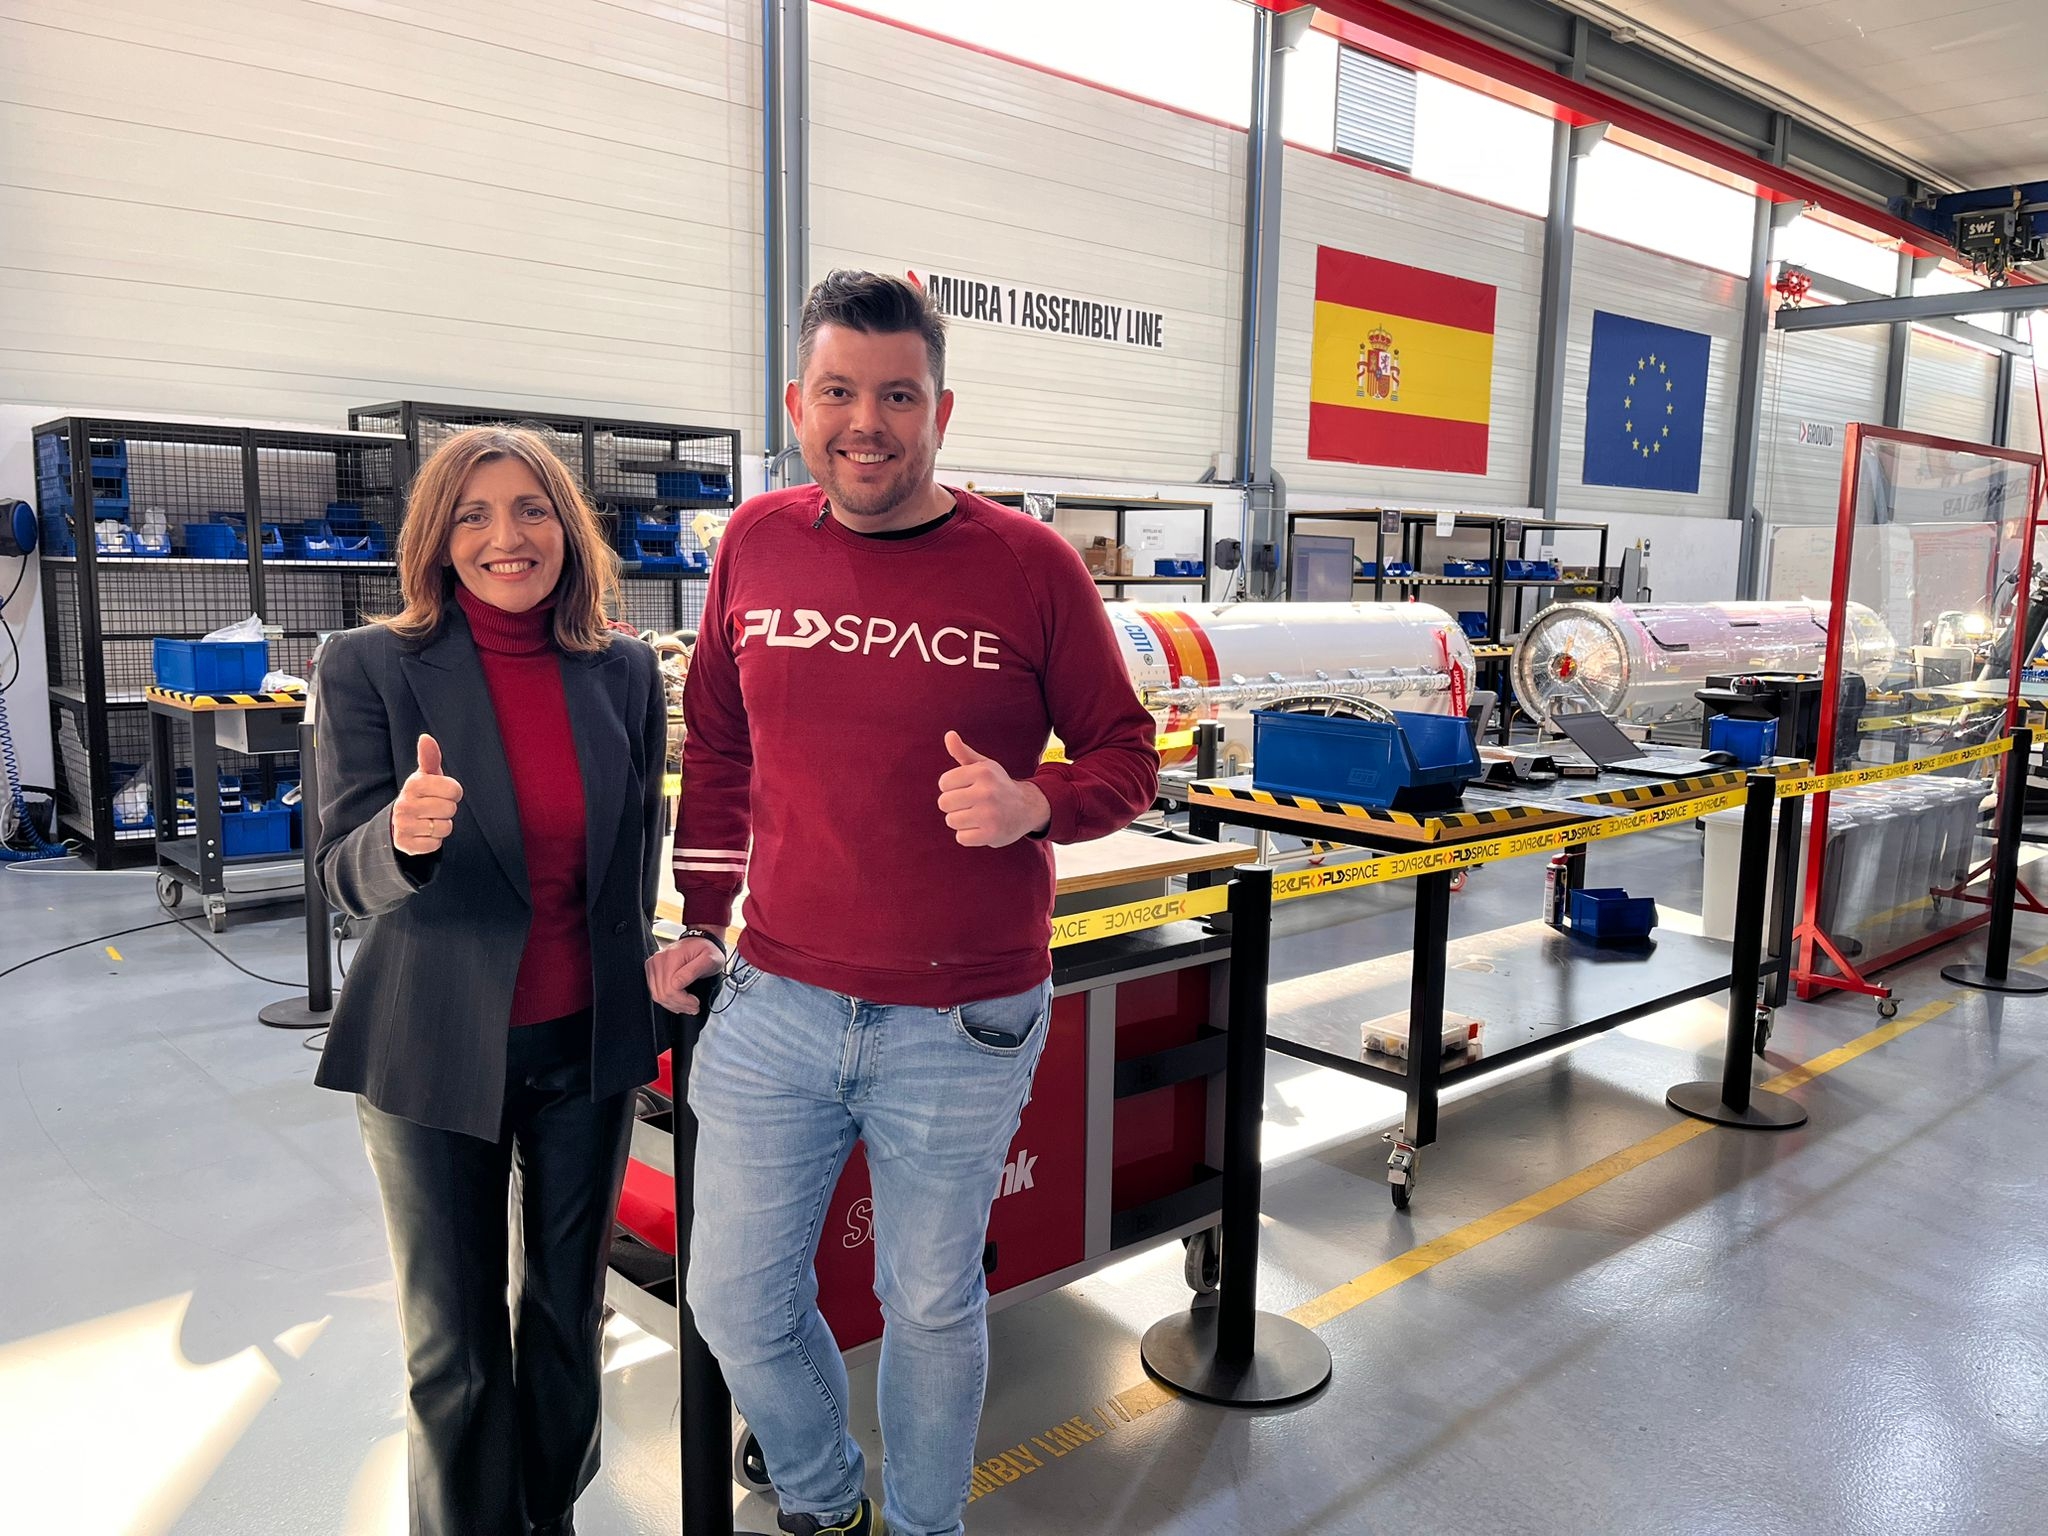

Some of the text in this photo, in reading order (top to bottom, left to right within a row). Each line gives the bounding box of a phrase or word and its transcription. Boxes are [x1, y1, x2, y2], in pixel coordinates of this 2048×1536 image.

[1968, 220, 1995, 235] SWF
[928, 274, 1163, 348] MIURA 1 ASSEMBLY LINE
[1807, 423, 1834, 447] GROUND
[1125, 624, 1154, 652] CDTI
[1030, 1415, 1105, 1458] LINE
